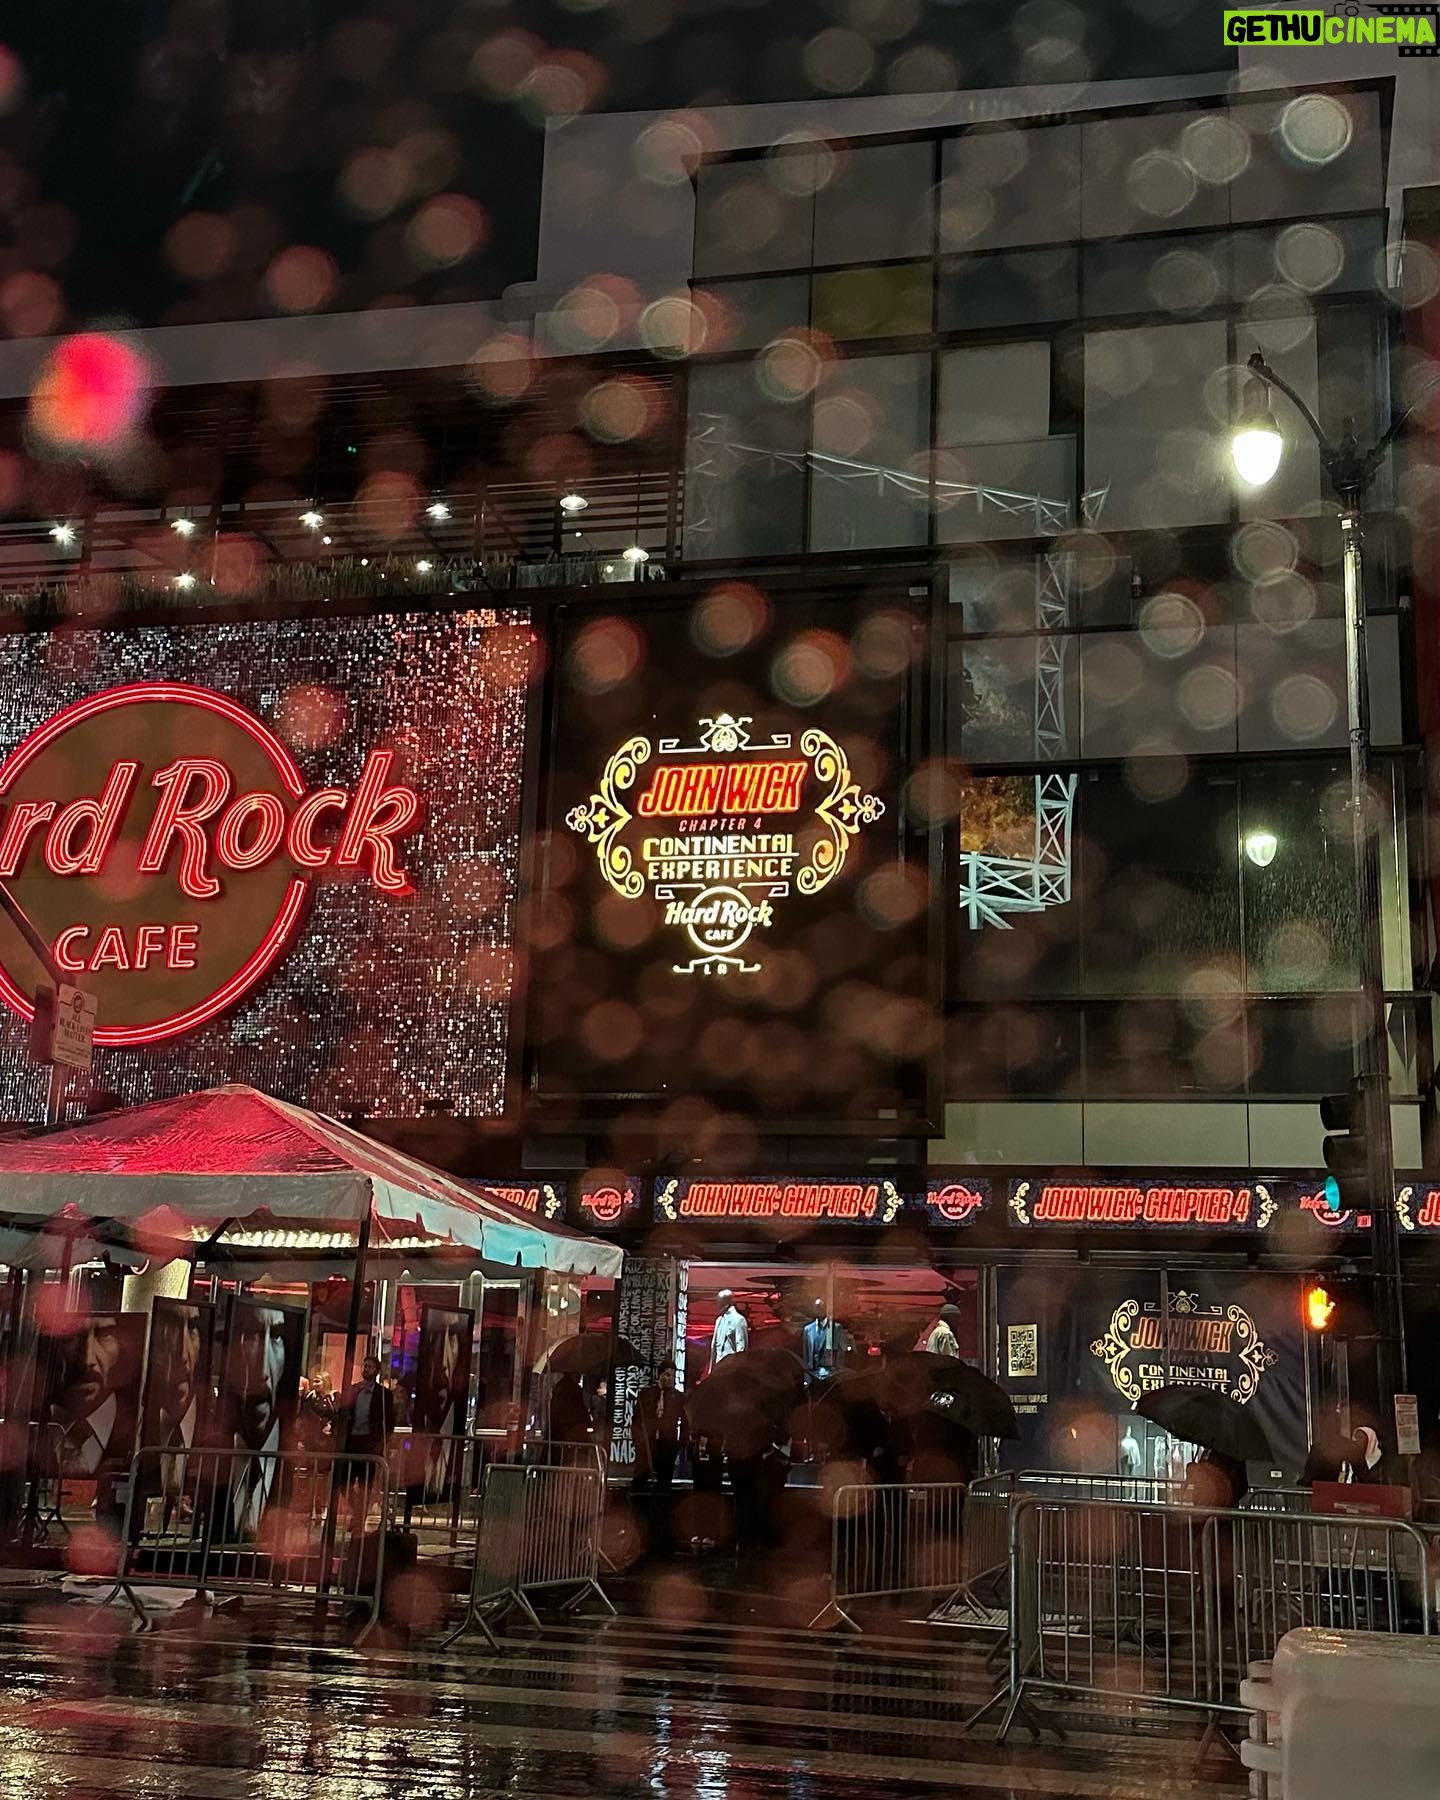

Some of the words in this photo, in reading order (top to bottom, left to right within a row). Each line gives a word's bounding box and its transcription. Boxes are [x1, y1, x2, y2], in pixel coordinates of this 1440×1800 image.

[638, 765, 725, 816] JOHN
[723, 761, 808, 813] WICK
[137, 748, 421, 900] Rock
[678, 819, 746, 832] CHAPTER
[754, 817, 762, 830] 4
[643, 834, 799, 861] CONTINENTAL
[649, 858, 793, 880] EXPERIENCE
[665, 900, 720, 925] Hard
[720, 899, 773, 928] Rock
[53, 922, 201, 971] CAFE
[705, 929, 734, 940] CAFE
[680, 1184, 731, 1216] JOHN
[730, 1184, 781, 1216] WICK:
[780, 1185, 864, 1217] CHAPTER
[863, 1186, 879, 1217] 4
[926, 1191, 955, 1205] Hard
[955, 1191, 982, 1207] Rock
[1034, 1187, 1089, 1219] JOHN
[1087, 1187, 1144, 1221] WICK:
[1144, 1188, 1233, 1222] CHAPTER
[1232, 1189, 1250, 1222] 4
[1131, 1317, 1183, 1349] JON
[1184, 1319, 1234, 1353] WICK
[614, 1383, 625, 1406] MINH
[613, 1409, 624, 1424] CHI
